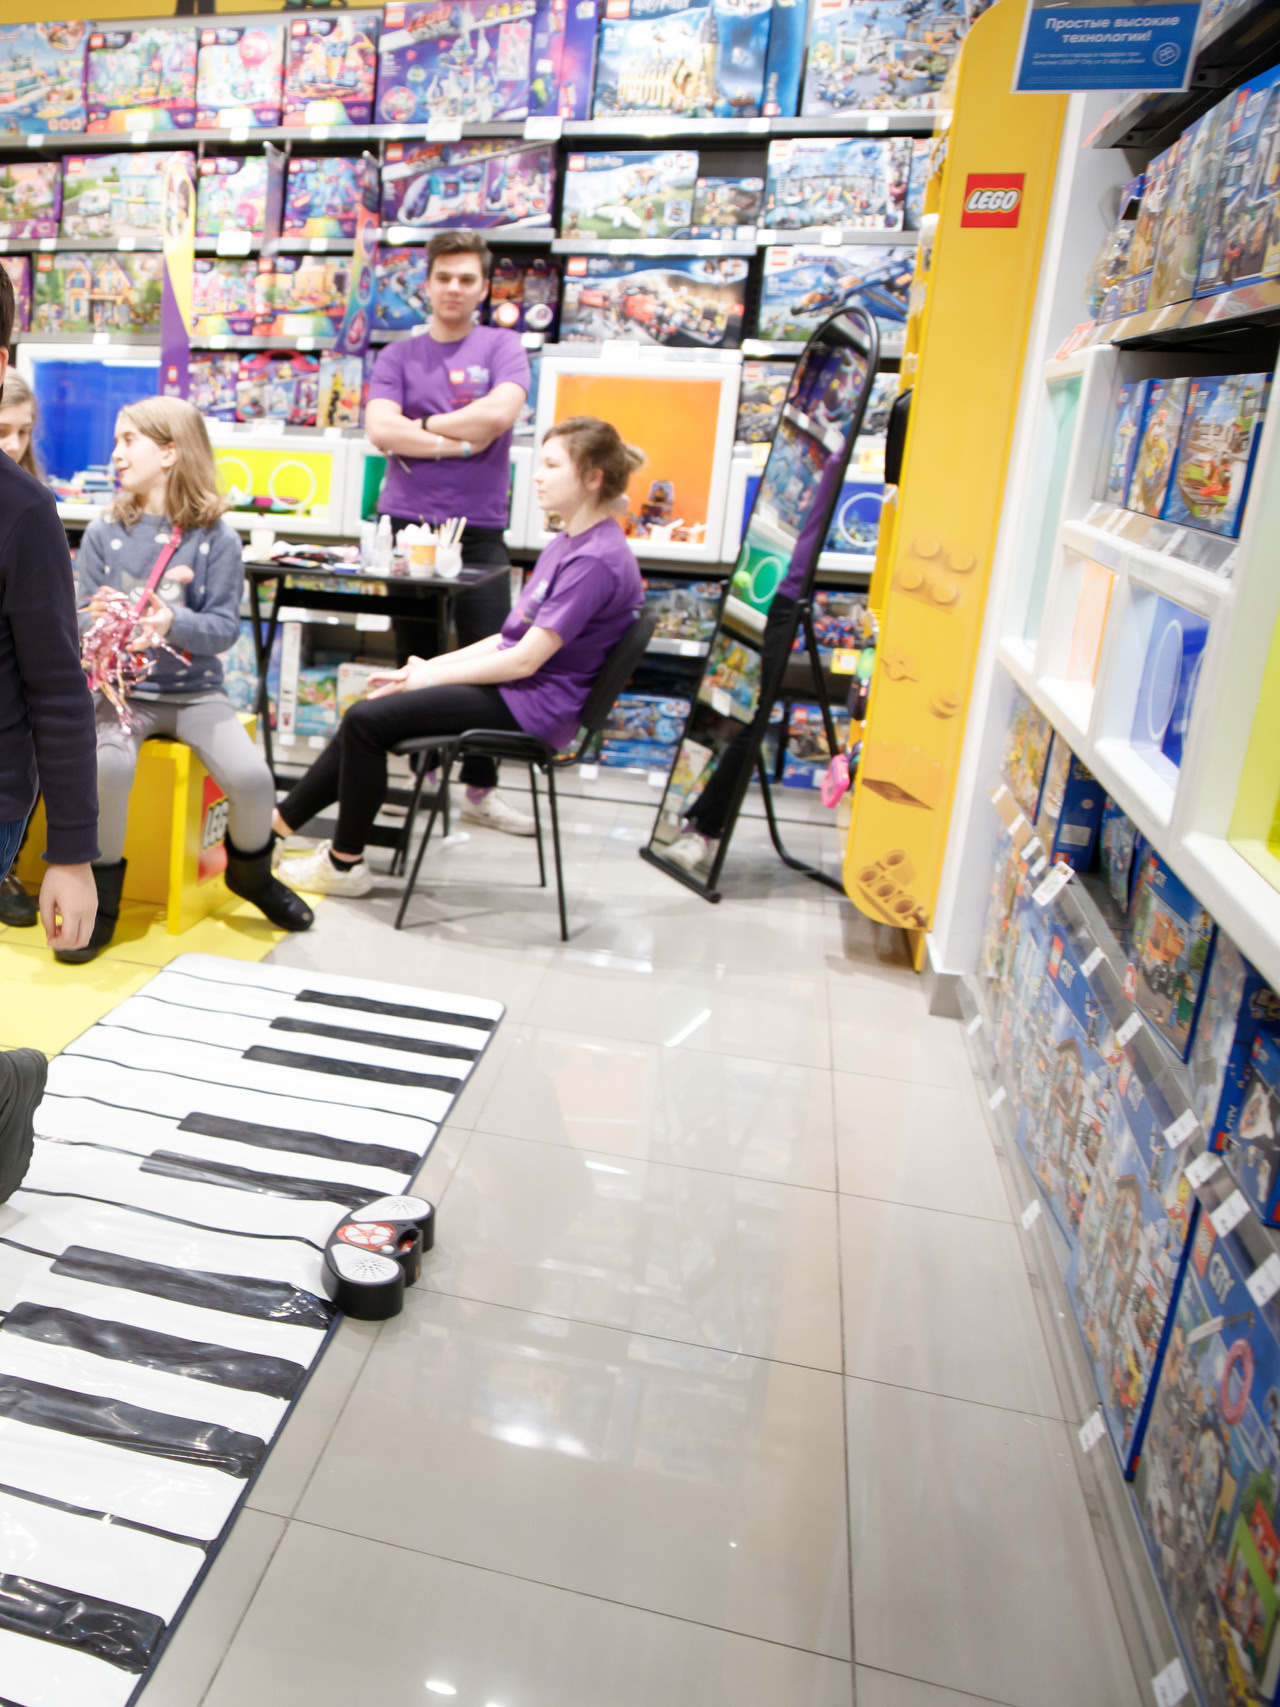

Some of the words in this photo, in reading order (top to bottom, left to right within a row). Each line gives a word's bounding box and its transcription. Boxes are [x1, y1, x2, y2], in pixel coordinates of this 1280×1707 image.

[1045, 17, 1111, 32] Простые
[1114, 15, 1180, 28] высокие
[1061, 30, 1153, 44] технологии!
[965, 189, 1020, 211] LEGO
[202, 800, 228, 850] LEG
